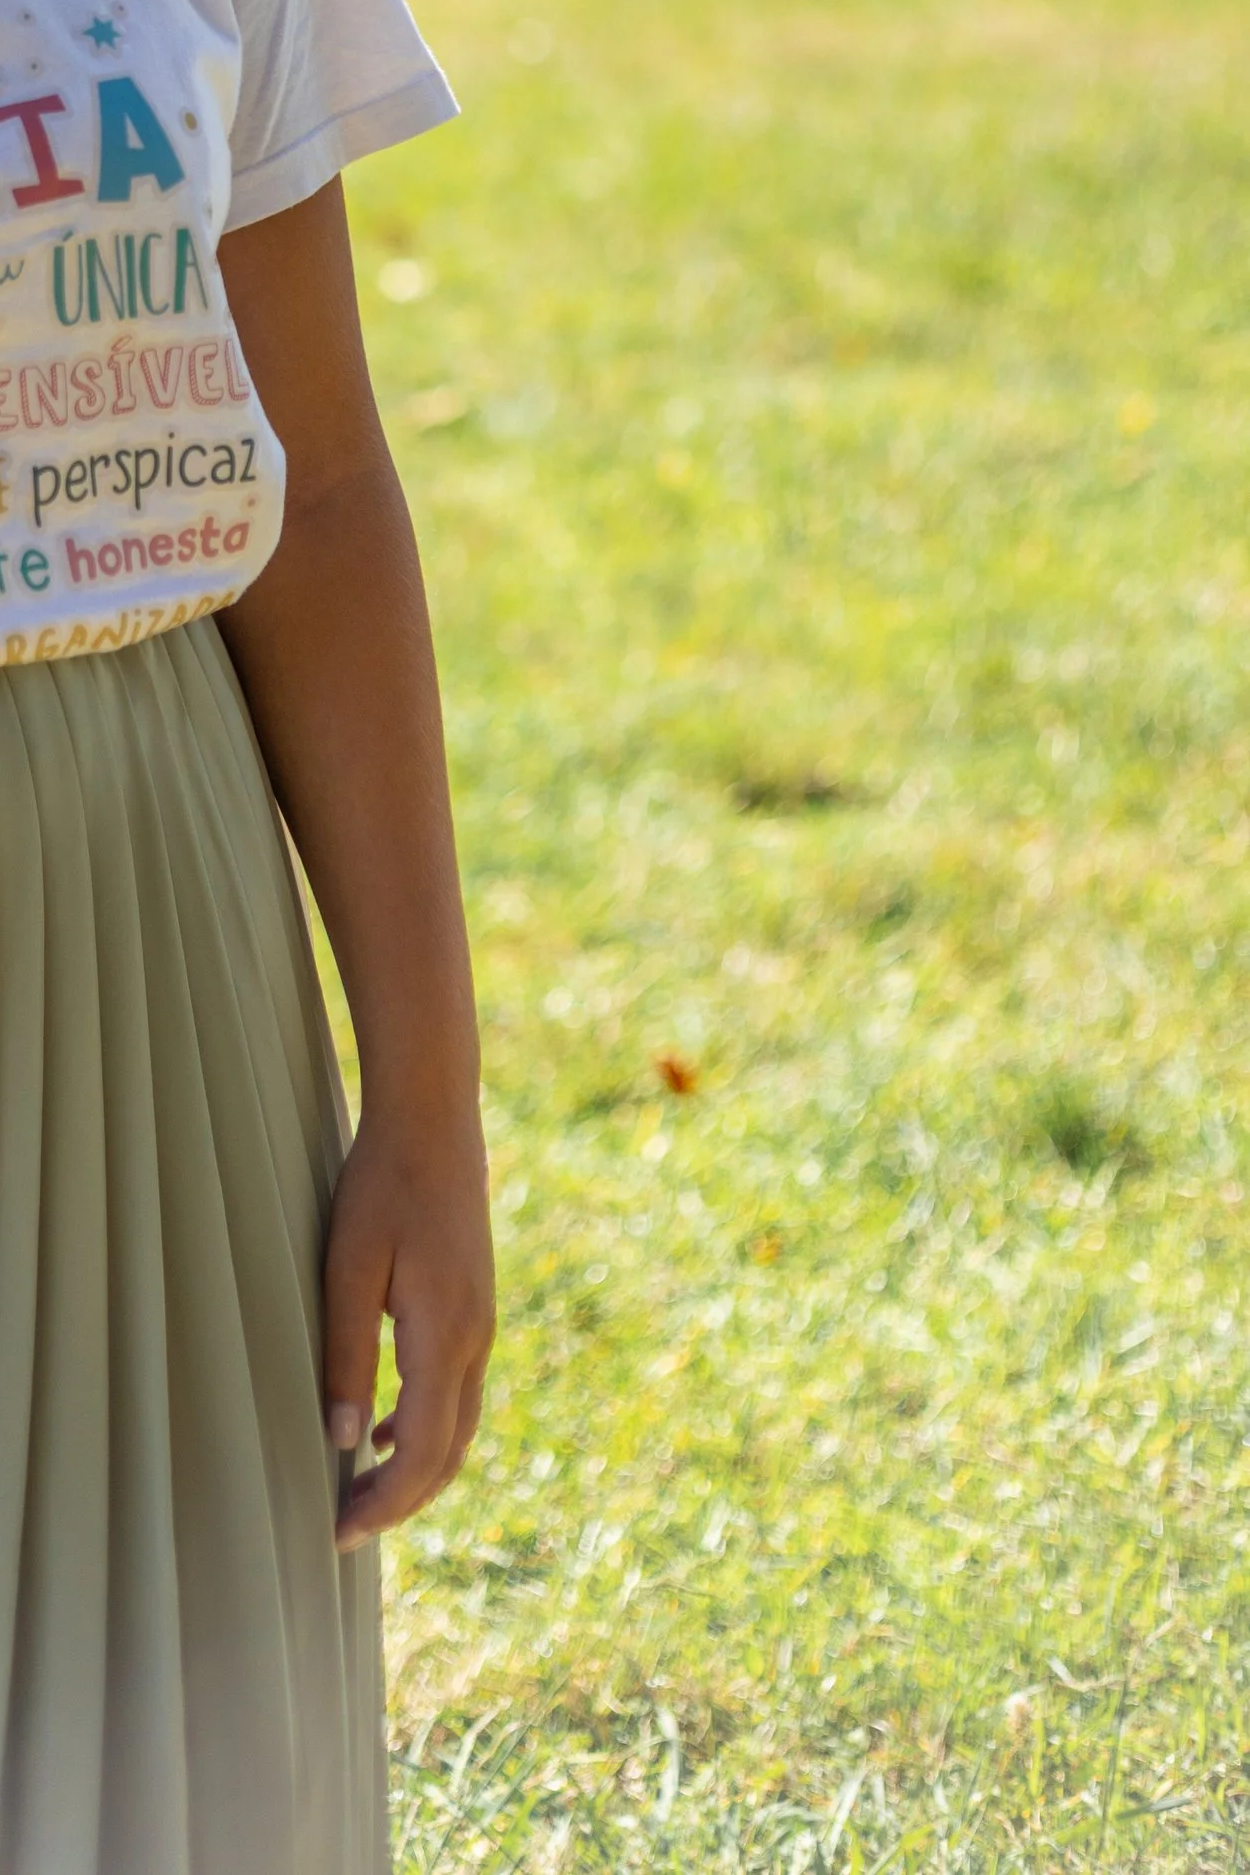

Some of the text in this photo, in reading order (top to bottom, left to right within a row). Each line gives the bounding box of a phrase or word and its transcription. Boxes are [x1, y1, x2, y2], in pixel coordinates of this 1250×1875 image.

[53, 228, 208, 326] ÚNICA
[32, 431, 257, 527] perspicaz
[66, 517, 248, 583] honesta
